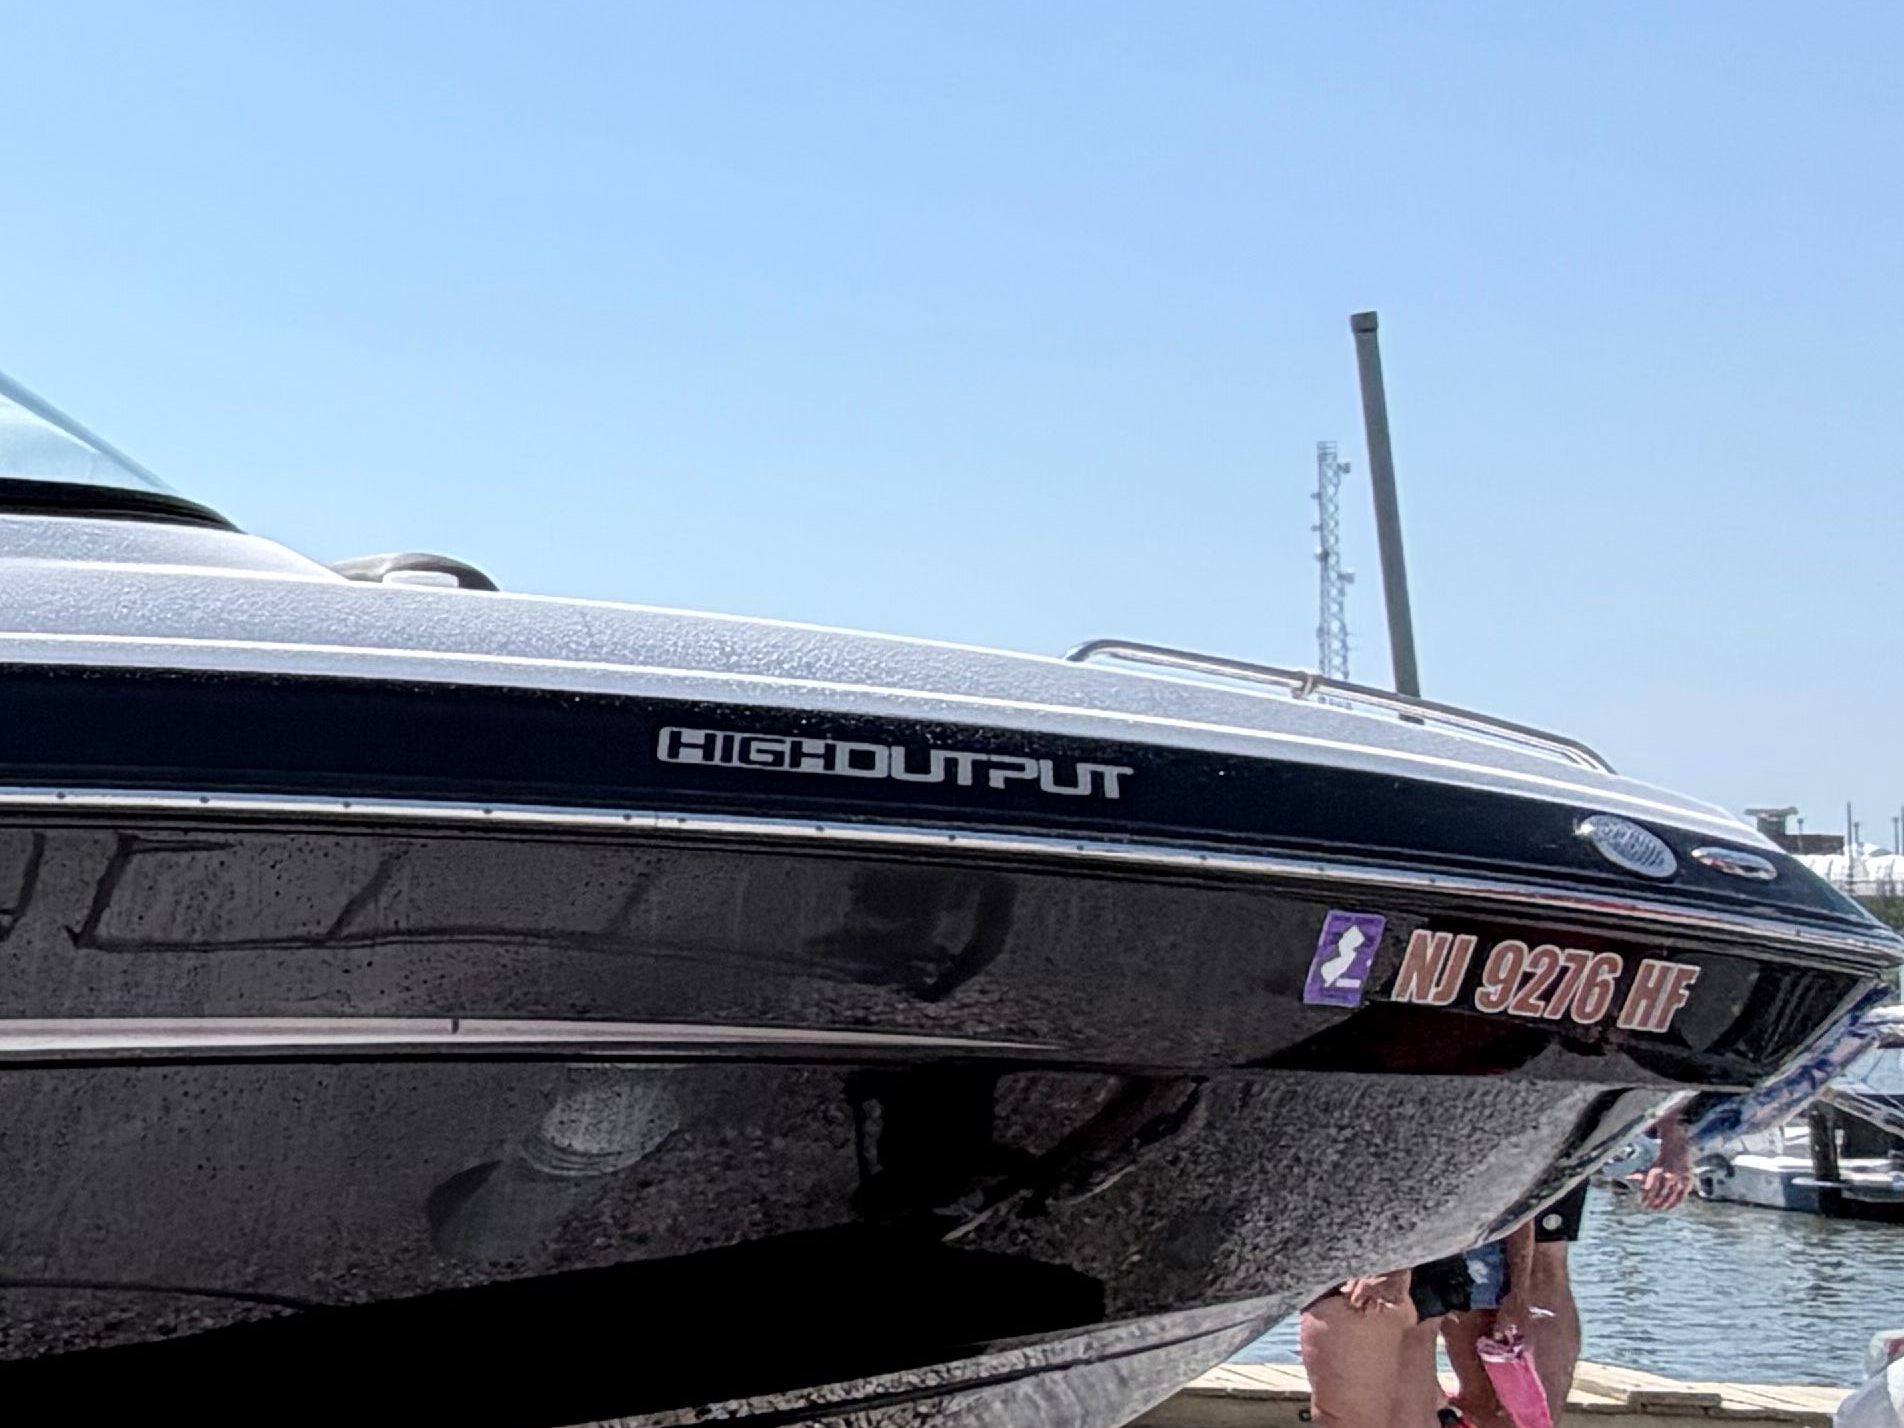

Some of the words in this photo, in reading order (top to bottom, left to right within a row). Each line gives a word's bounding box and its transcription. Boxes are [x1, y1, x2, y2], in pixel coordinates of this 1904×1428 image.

[1391, 928, 1478, 1006] NJ
[1474, 939, 1622, 1024] 9276
[1616, 958, 1700, 1033] HF
